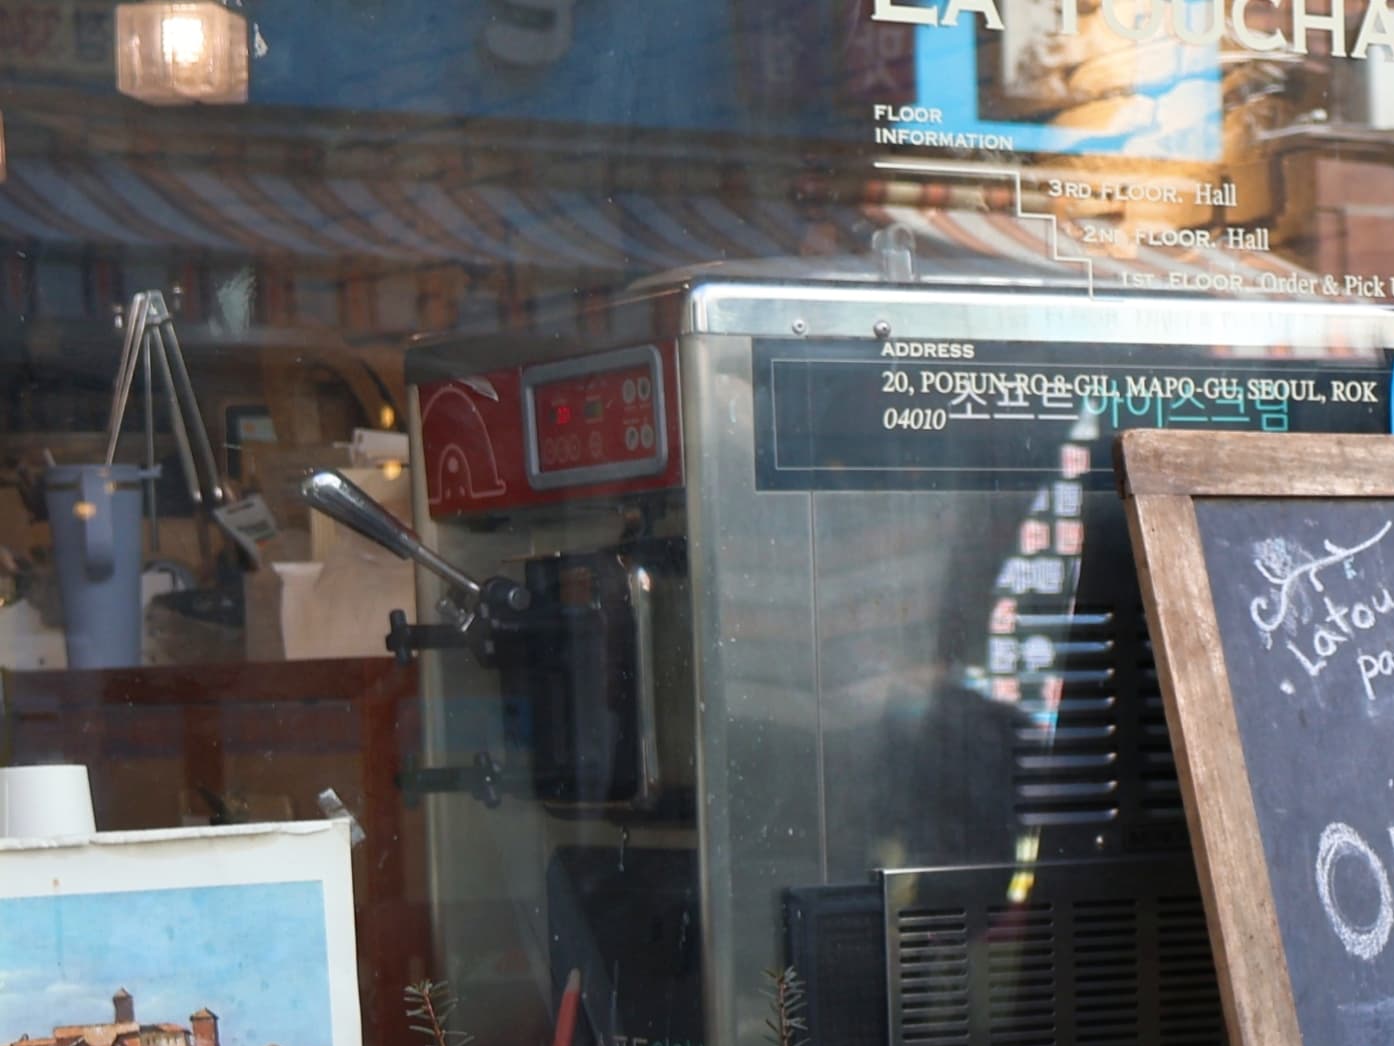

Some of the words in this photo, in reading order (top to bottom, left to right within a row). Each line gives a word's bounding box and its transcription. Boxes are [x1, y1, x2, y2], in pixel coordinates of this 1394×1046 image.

[873, 104, 942, 123] FLOOR
[874, 127, 1014, 151] INFORMATION
[1048, 179, 1092, 199] 3RD
[1101, 184, 1183, 204] FLOOR.
[1193, 183, 1238, 206] Hall
[1135, 229, 1217, 248] FLOOR.
[1227, 228, 1270, 250] Hall
[1260, 272, 1318, 295] Order
[1322, 277, 1339, 296] &
[1344, 275, 1385, 298] Pick
[881, 342, 975, 359] ADDRESS
[882, 371, 914, 396] 20,
[1125, 376, 1244, 402] MAPO-GU,
[1247, 378, 1327, 404] SEOUL,
[1331, 381, 1379, 403] ROK
[883, 408, 947, 431] 04010
